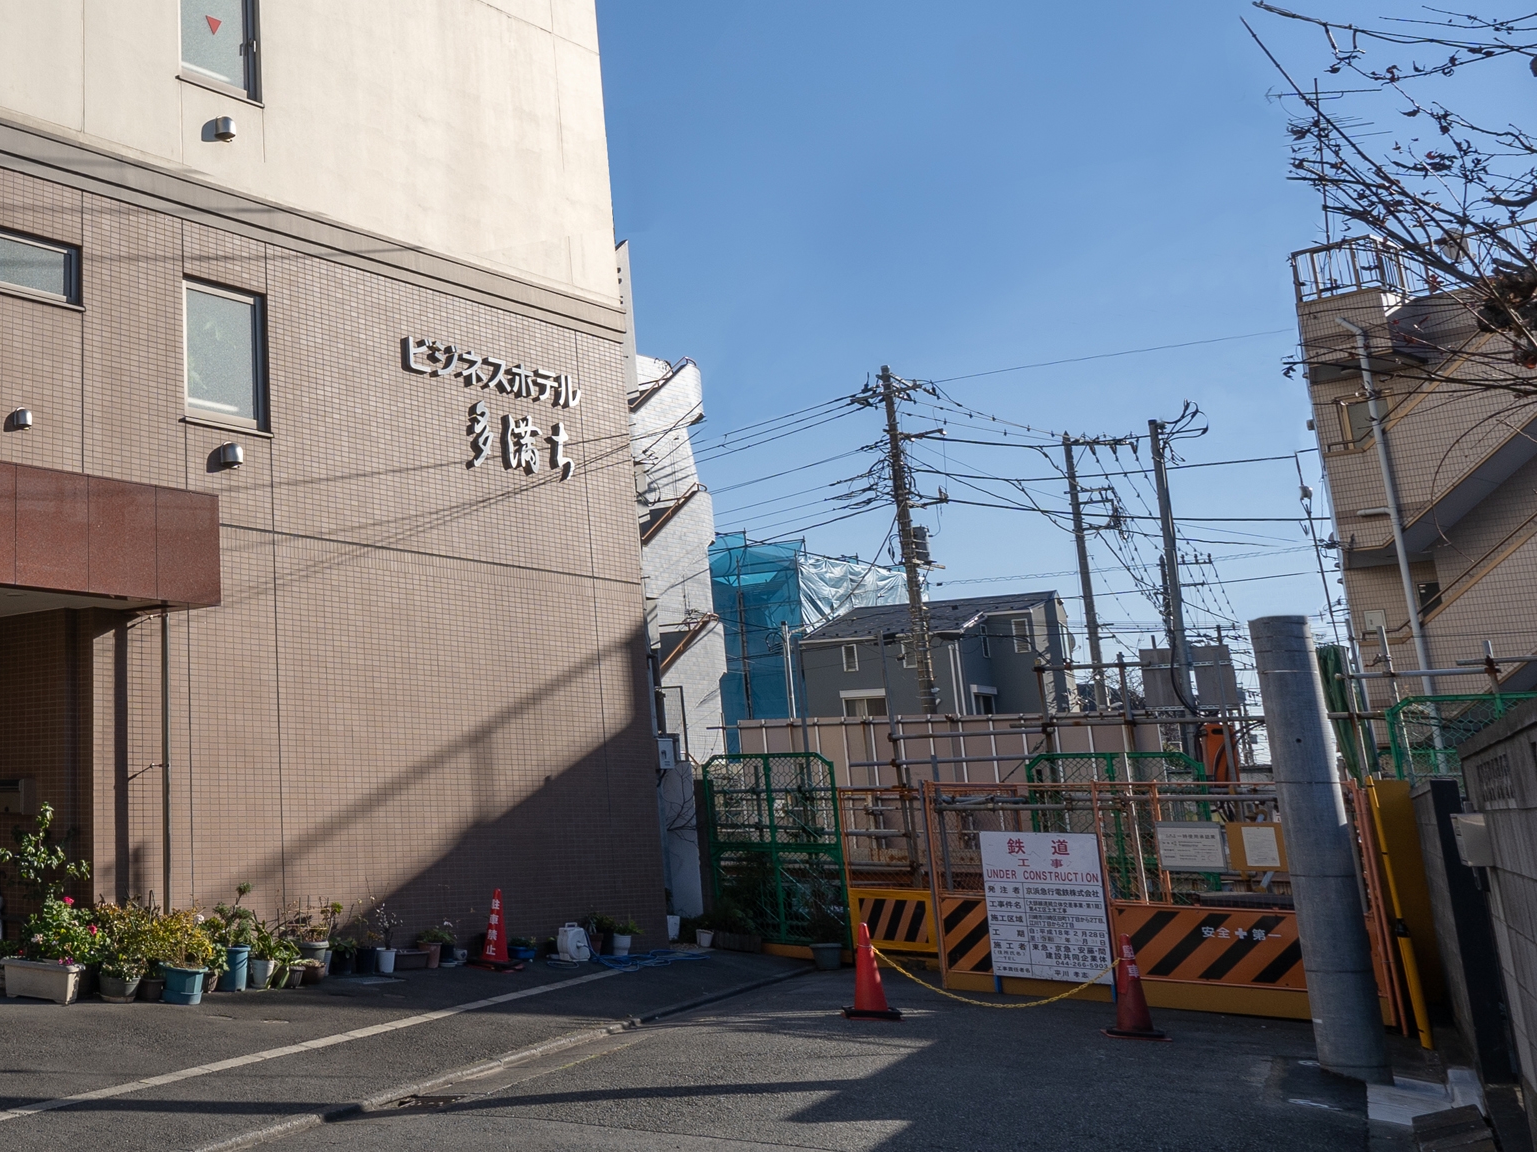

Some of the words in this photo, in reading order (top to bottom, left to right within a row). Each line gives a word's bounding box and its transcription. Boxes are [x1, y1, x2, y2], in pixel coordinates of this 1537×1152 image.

[400, 336, 581, 409] ビジネスホテル
[1007, 838, 1070, 856] 鉄道
[1018, 858, 1063, 868] 工事
[986, 869, 1017, 879] UNDER
[1023, 870, 1099, 883] CONSTRUCTION
[988, 886, 1021, 895] 発注者
[486, 898, 500, 955] 駐車禁止
[1201, 926, 1230, 939] 安全
[1252, 929, 1281, 941] 第一
